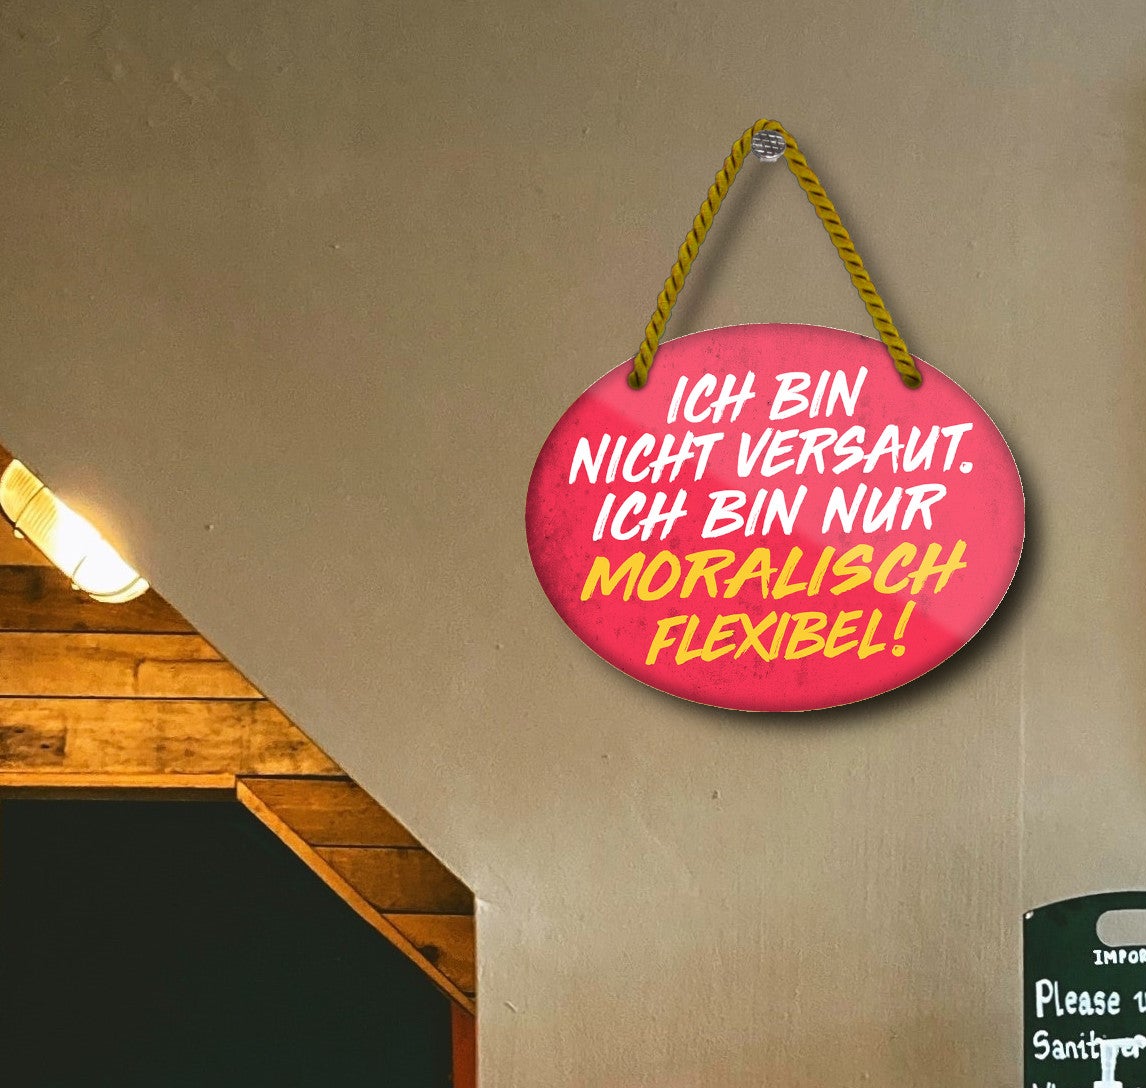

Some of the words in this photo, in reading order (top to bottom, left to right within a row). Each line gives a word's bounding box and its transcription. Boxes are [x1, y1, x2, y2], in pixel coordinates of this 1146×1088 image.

[666, 370, 755, 424] ICH
[769, 366, 868, 420] BIN
[568, 431, 724, 485] NICHT
[736, 422, 974, 478] VERSAUT.
[592, 489, 688, 542] ICH
[701, 484, 808, 539] BIN
[821, 483, 947, 534] NUR
[580, 539, 967, 602] MORALISCH
[645, 600, 916, 665] FLEXIBEL!
[1035, 978, 1120, 1018] Please
[1032, 1029, 1143, 1060] Saniter
